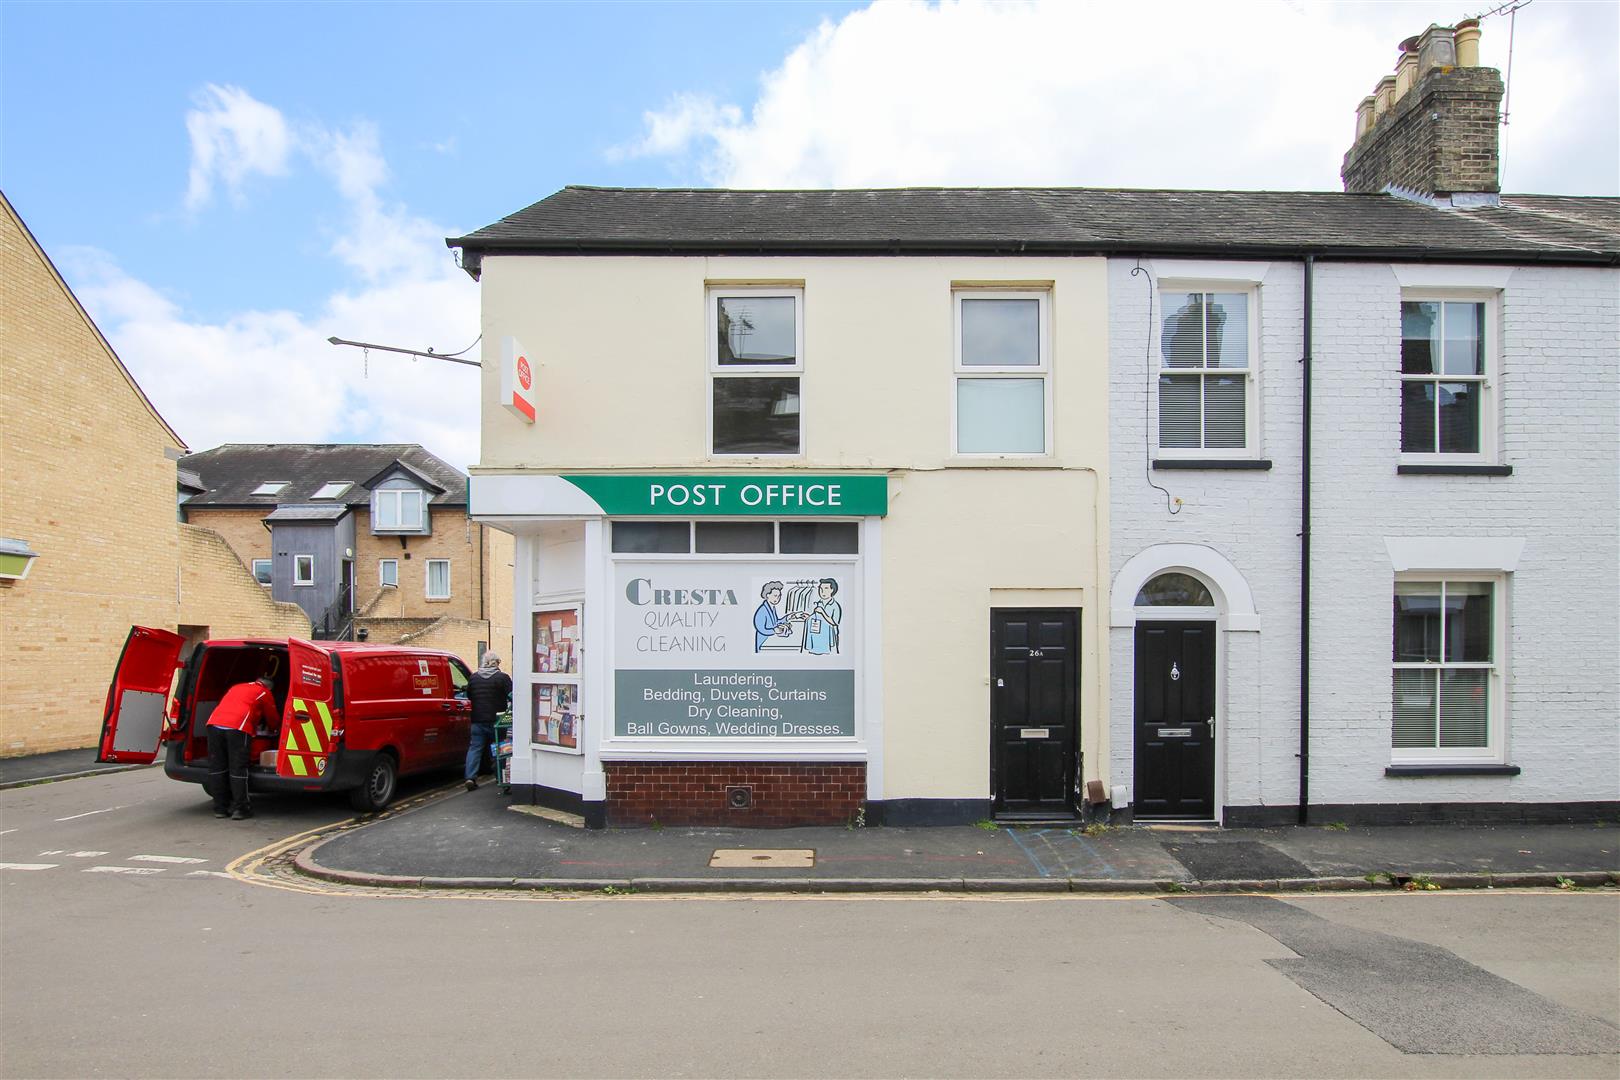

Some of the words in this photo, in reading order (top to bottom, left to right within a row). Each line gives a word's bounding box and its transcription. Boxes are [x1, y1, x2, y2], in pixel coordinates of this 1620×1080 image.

[650, 484, 726, 506] POST
[740, 484, 842, 506] OFFICE
[625, 578, 738, 606] CRESTA
[644, 611, 719, 630] QUALITY
[636, 635, 726, 652] CLEANING
[694, 673, 777, 688] Laundering,
[643, 688, 705, 704] Bedding,
[710, 688, 763, 702] Duvets,
[768, 688, 827, 701] Curtains
[688, 705, 713, 720] Dry
[716, 705, 783, 720] Cleaning,
[627, 722, 653, 735] Ball
[658, 722, 711, 736] Gowns,
[715, 722, 778, 737] Wedding
[782, 722, 844, 735] Dresses.
